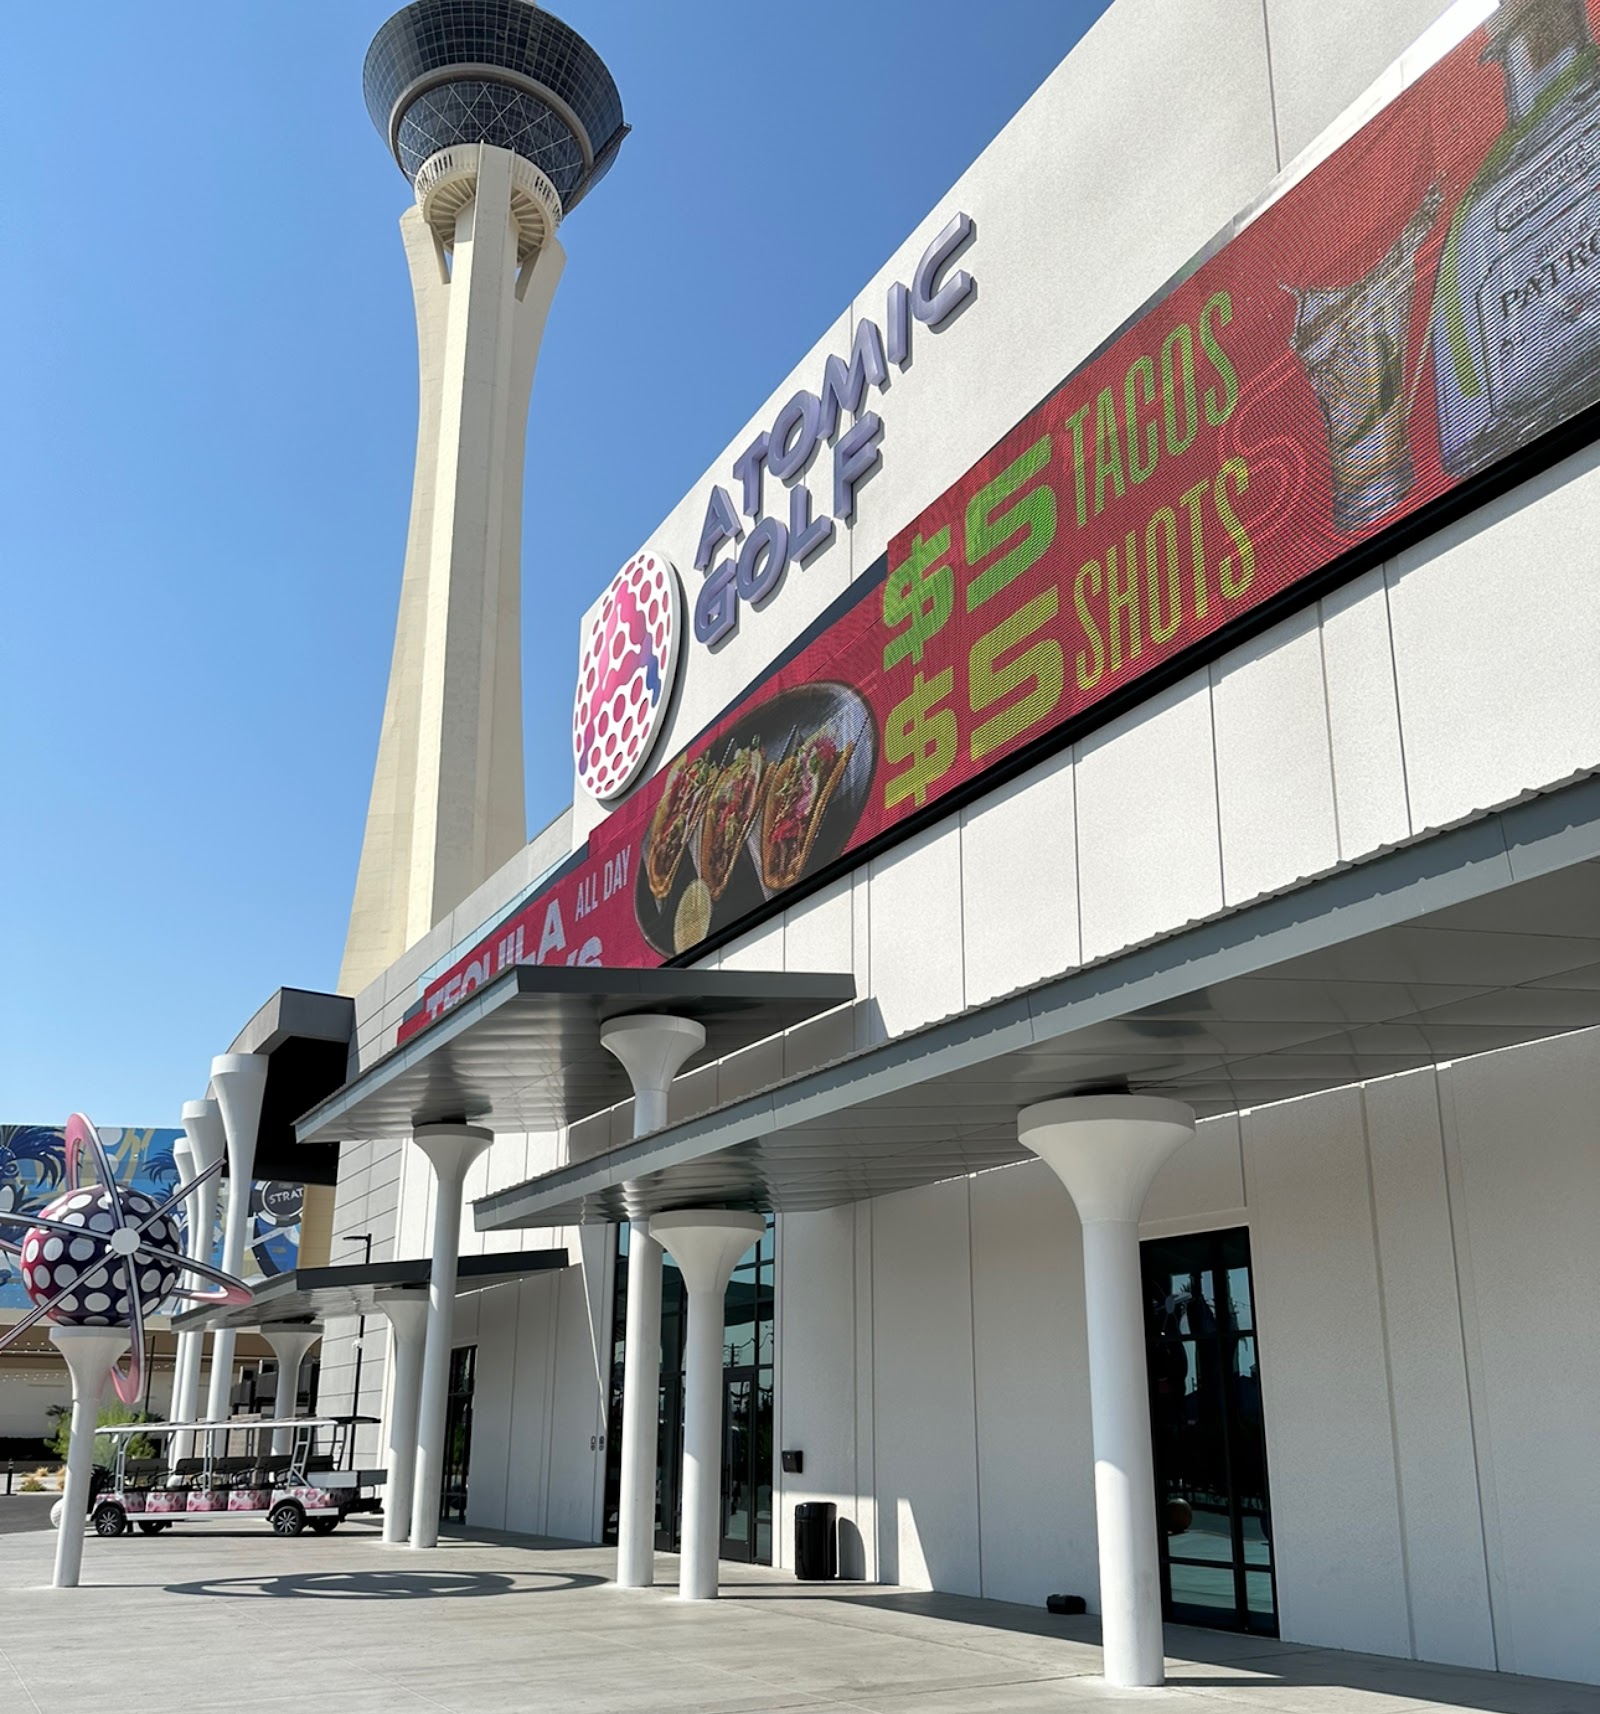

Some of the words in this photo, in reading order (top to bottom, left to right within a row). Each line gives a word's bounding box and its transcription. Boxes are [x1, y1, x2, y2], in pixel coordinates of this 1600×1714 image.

[694, 210, 973, 573] ATOMIC
[694, 410, 880, 647] GOLF
[883, 433, 1058, 672] $5
[1065, 290, 1239, 528] TACOS
[884, 585, 1065, 809] $5
[1074, 456, 1255, 690] SHOTS
[574, 871, 599, 923] ALL
[603, 844, 632, 902] DAY
[268, 1186, 304, 1205] STRAT
